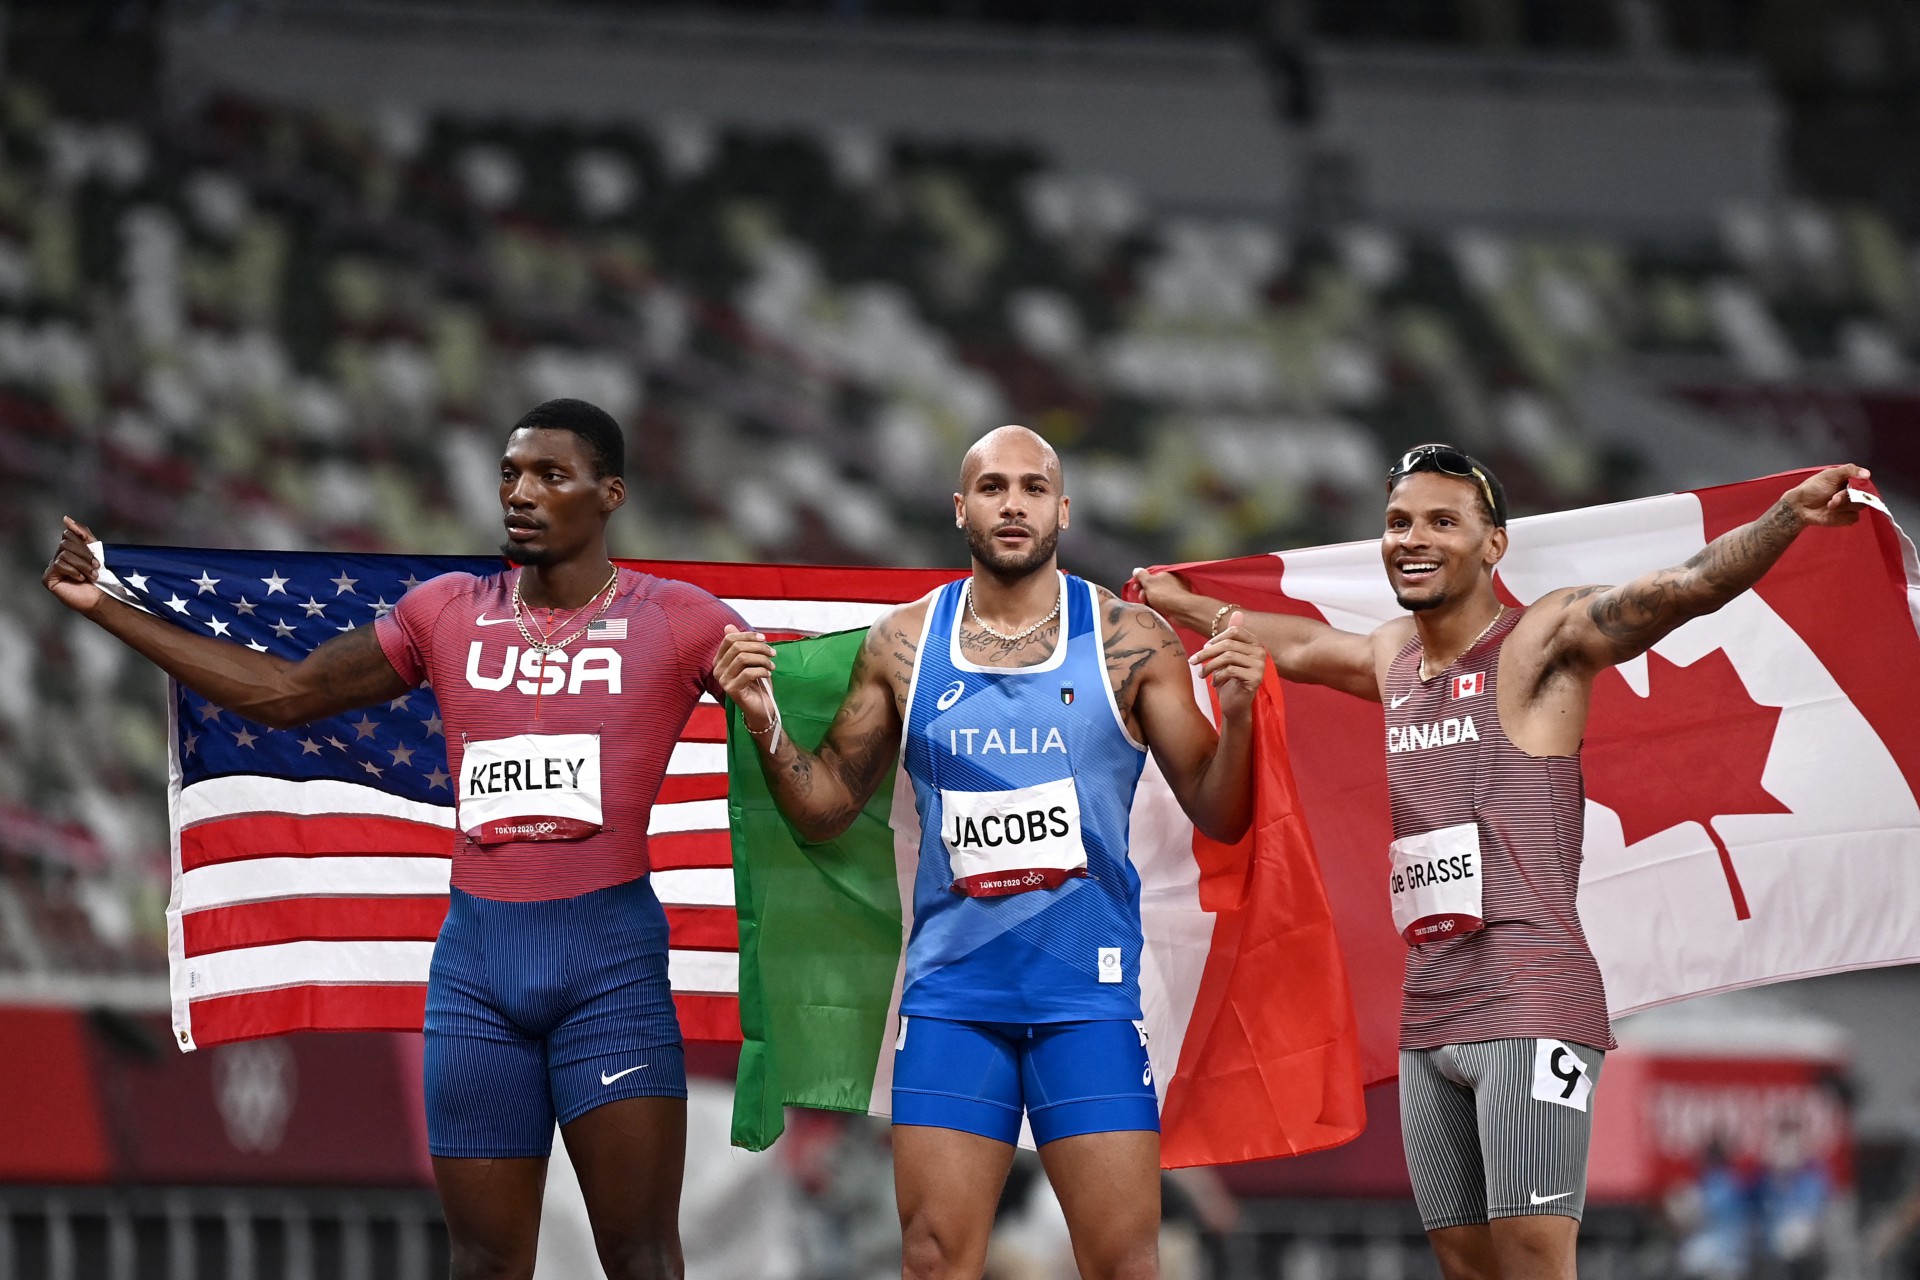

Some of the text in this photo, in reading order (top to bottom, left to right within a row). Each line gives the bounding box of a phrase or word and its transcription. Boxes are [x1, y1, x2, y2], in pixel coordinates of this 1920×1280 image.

[466, 641, 622, 695] USA
[950, 727, 1068, 755] ITALIA
[1389, 716, 1480, 753] CANADA
[470, 758, 585, 796] KERLEY
[494, 825, 534, 835] TOKYO 2020
[950, 806, 1069, 848] JACOBS
[979, 879, 1021, 889] TOKYO 2020
[1391, 854, 1474, 894] de GRASSE
[1550, 1047, 1582, 1099] 9
